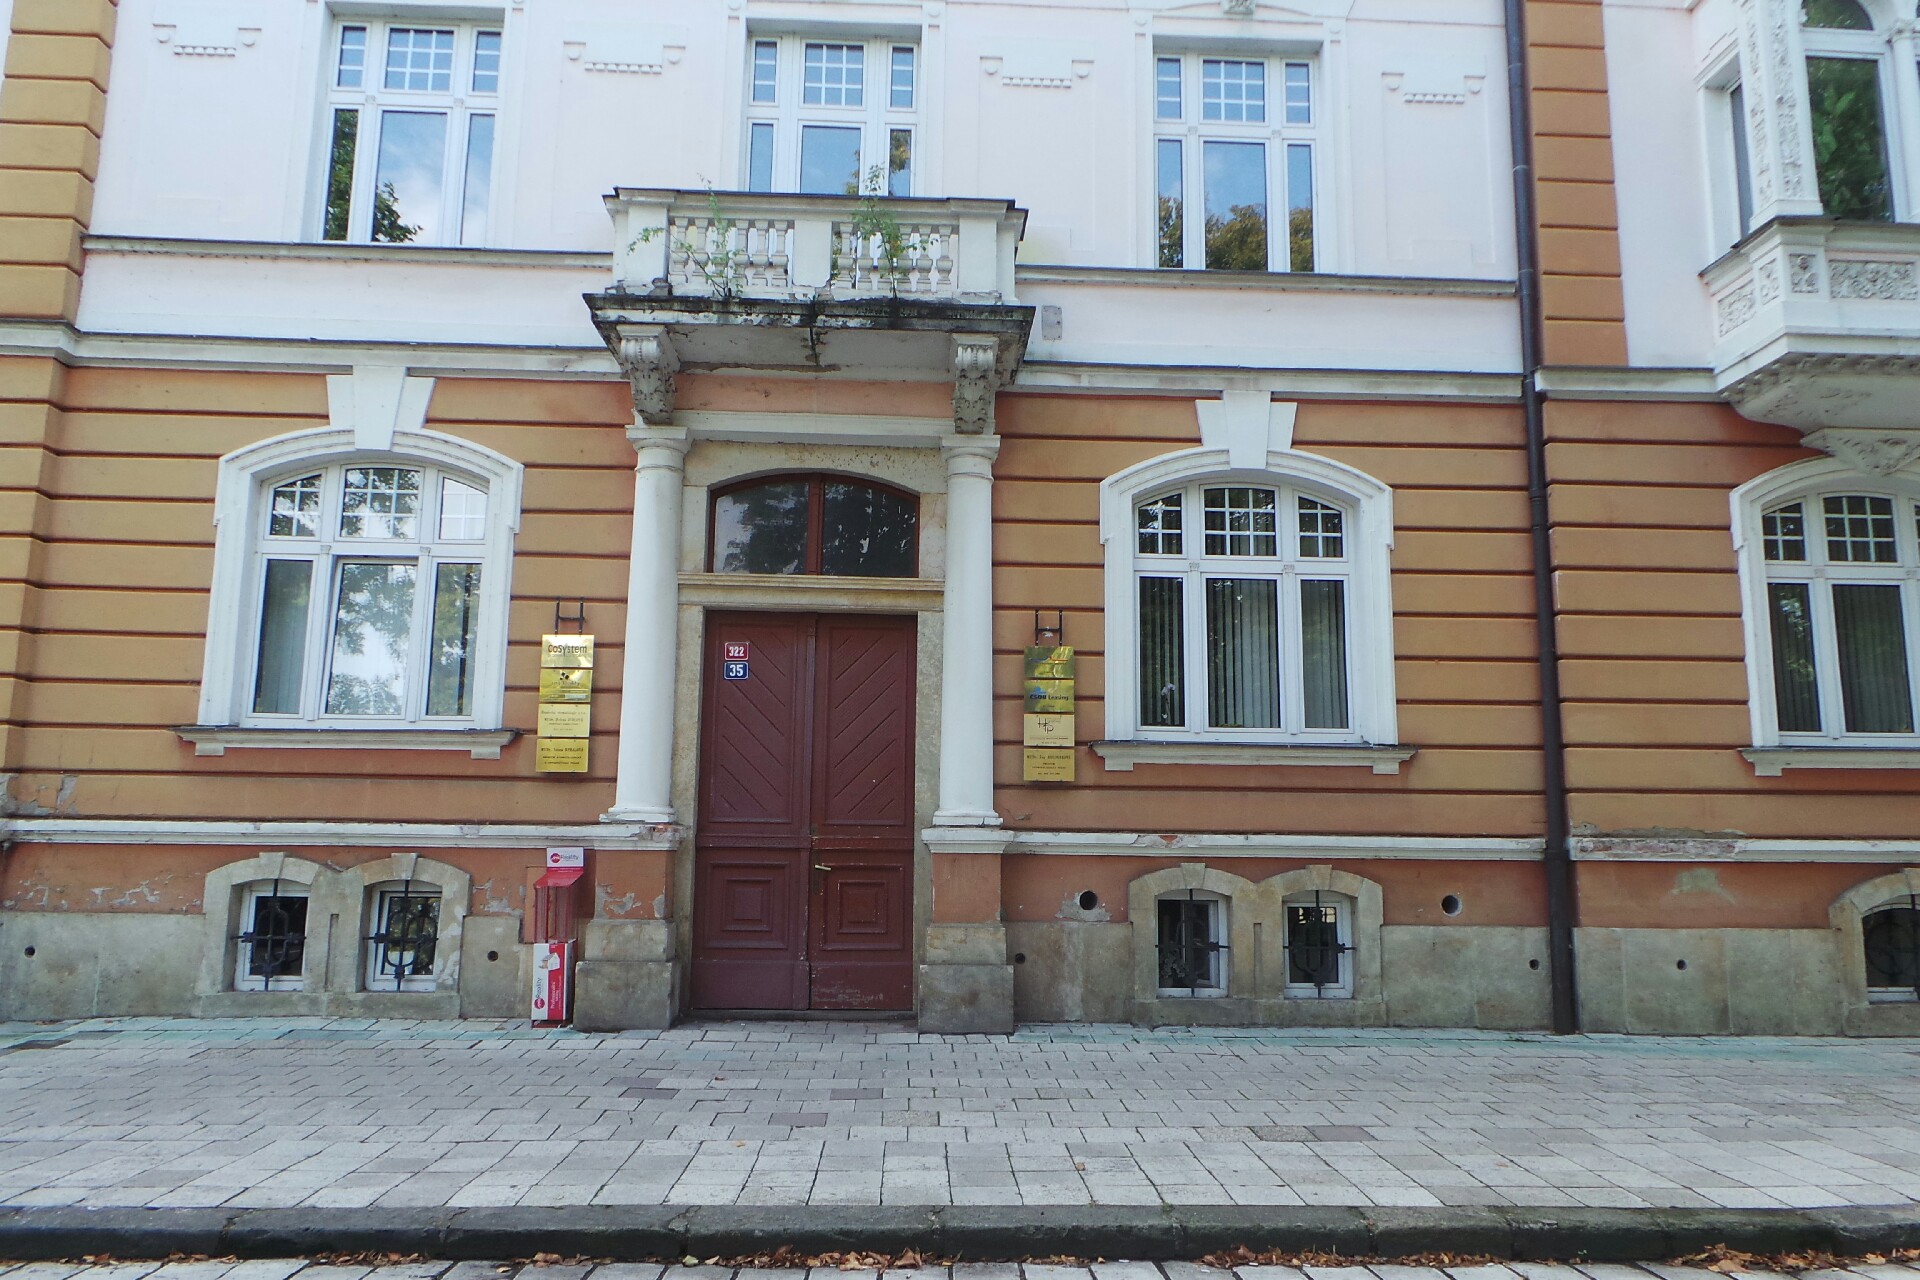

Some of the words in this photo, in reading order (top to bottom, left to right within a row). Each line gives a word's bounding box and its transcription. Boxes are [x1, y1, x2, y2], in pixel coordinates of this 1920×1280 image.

[548, 643, 587, 656] CoSystem
[729, 646, 744, 657] 322
[729, 664, 744, 677] 35
